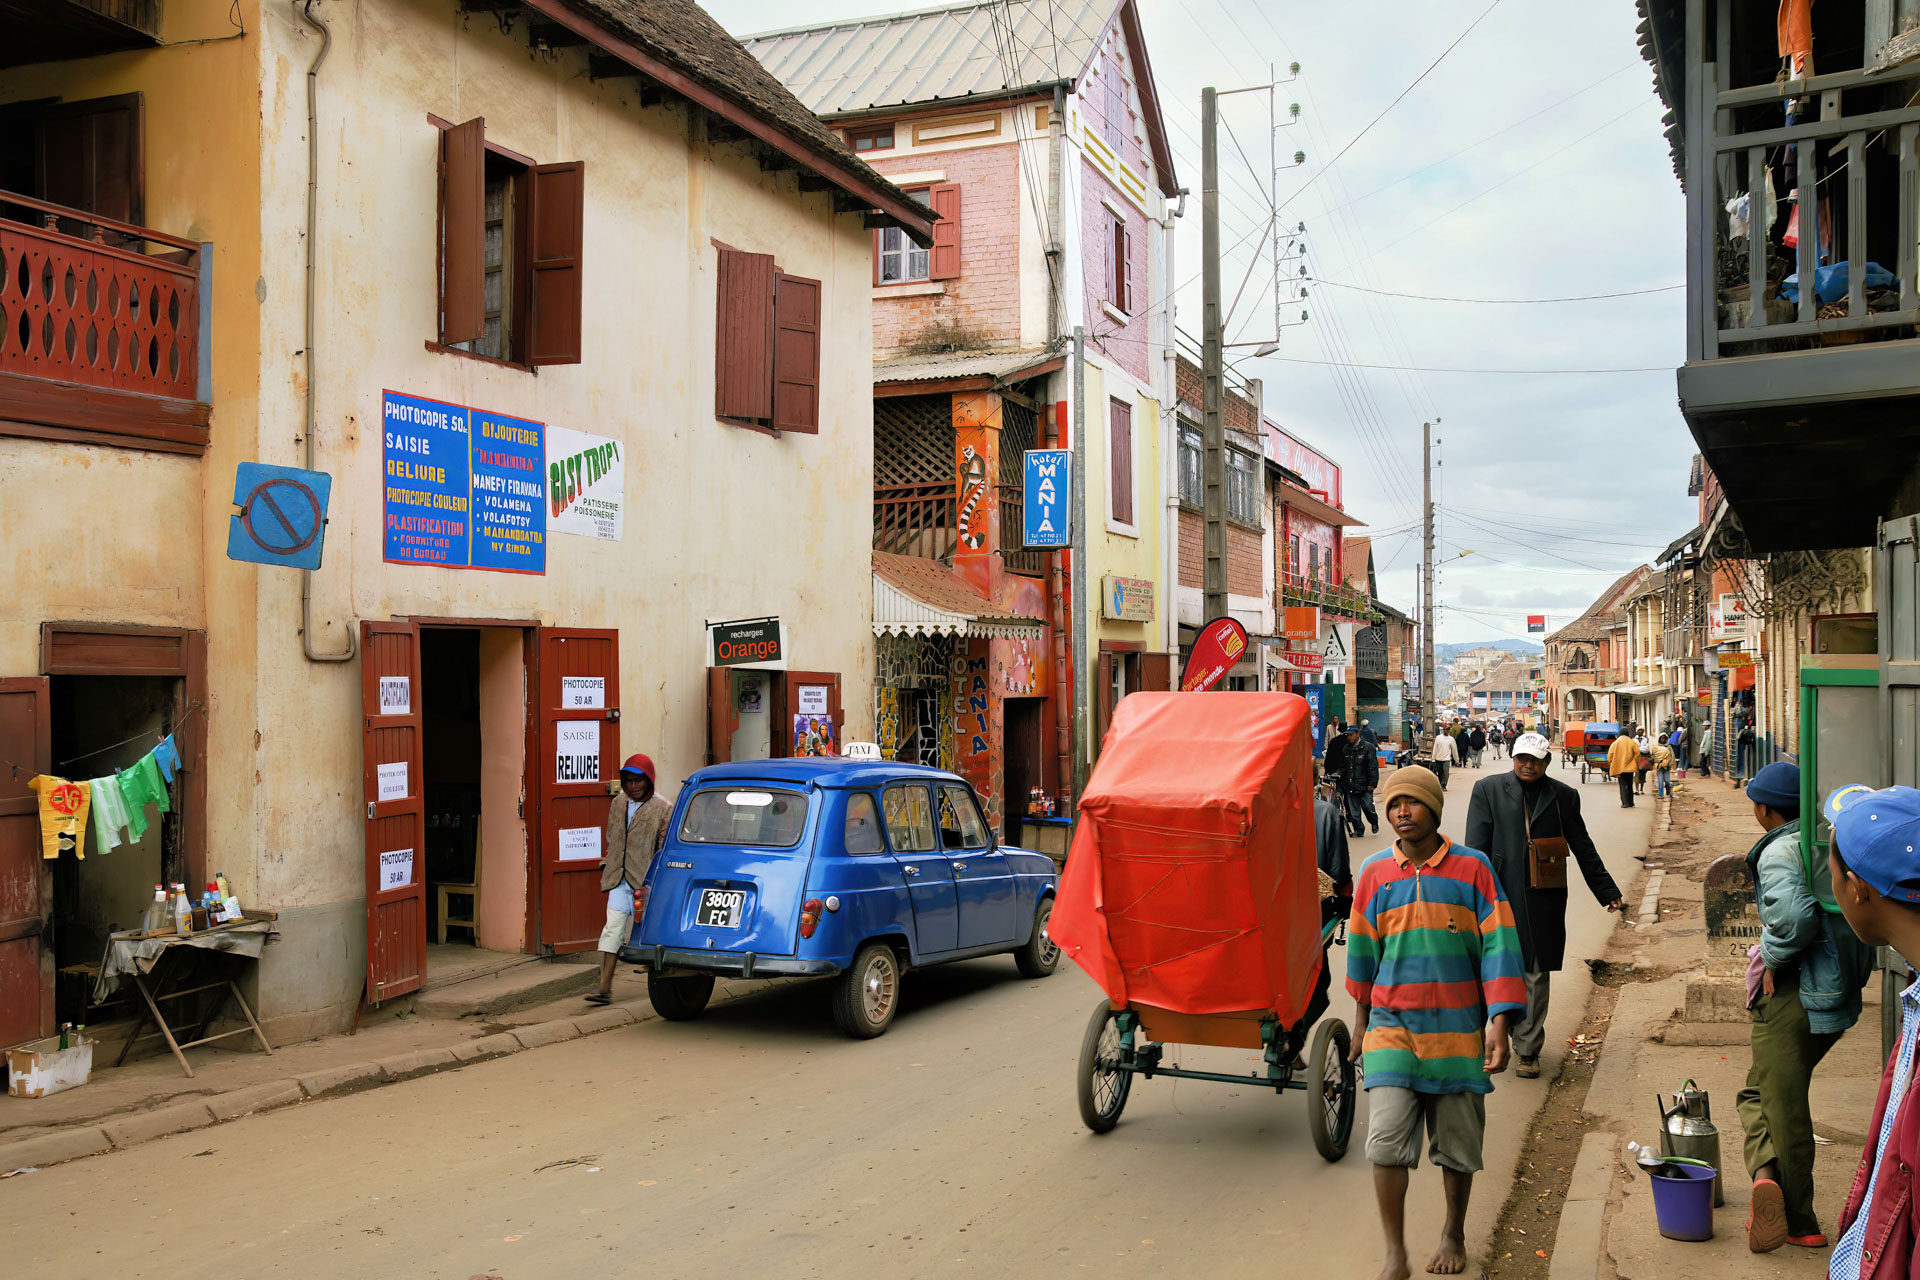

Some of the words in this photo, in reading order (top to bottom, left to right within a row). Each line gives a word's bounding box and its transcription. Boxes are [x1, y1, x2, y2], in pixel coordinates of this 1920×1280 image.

[385, 401, 448, 430] PHOTOCOPIE
[482, 421, 539, 447] BIJOUTERIE
[386, 432, 430, 455] SAISIE
[1031, 453, 1064, 467] hotel
[387, 459, 446, 484] RELIURE
[473, 473, 506, 494] MANEFY
[507, 479, 542, 498] FIRAVAKA
[387, 486, 432, 507] PHOTOCOPIE
[433, 494, 467, 512] COULEUR
[484, 495, 532, 513] VOLAMENA
[583, 497, 619, 511] PATISSERIE
[1038, 463, 1056, 532] MANIA
[483, 511, 531, 528] VOLAFOTSY
[574, 506, 615, 520] POISSONERIE
[388, 513, 464, 537] PLASTIFICATION
[730, 628, 764, 639] recharges
[1286, 630, 1313, 639] orange
[718, 640, 778, 659] Orange
[563, 679, 604, 689] PHOTOCOPIE
[574, 695, 583, 705] 50
[583, 695, 593, 705] AR
[968, 656, 989, 755] MANIA
[563, 731, 594, 740] SAISIE
[847, 745, 871, 755] TAXI
[558, 755, 598, 780] RELIURE
[381, 850, 413, 866] PHOTOCOPIE
[705, 891, 741, 908] 3800
[709, 909, 728, 926] FC
[1729, 942, 1756, 956] 25
